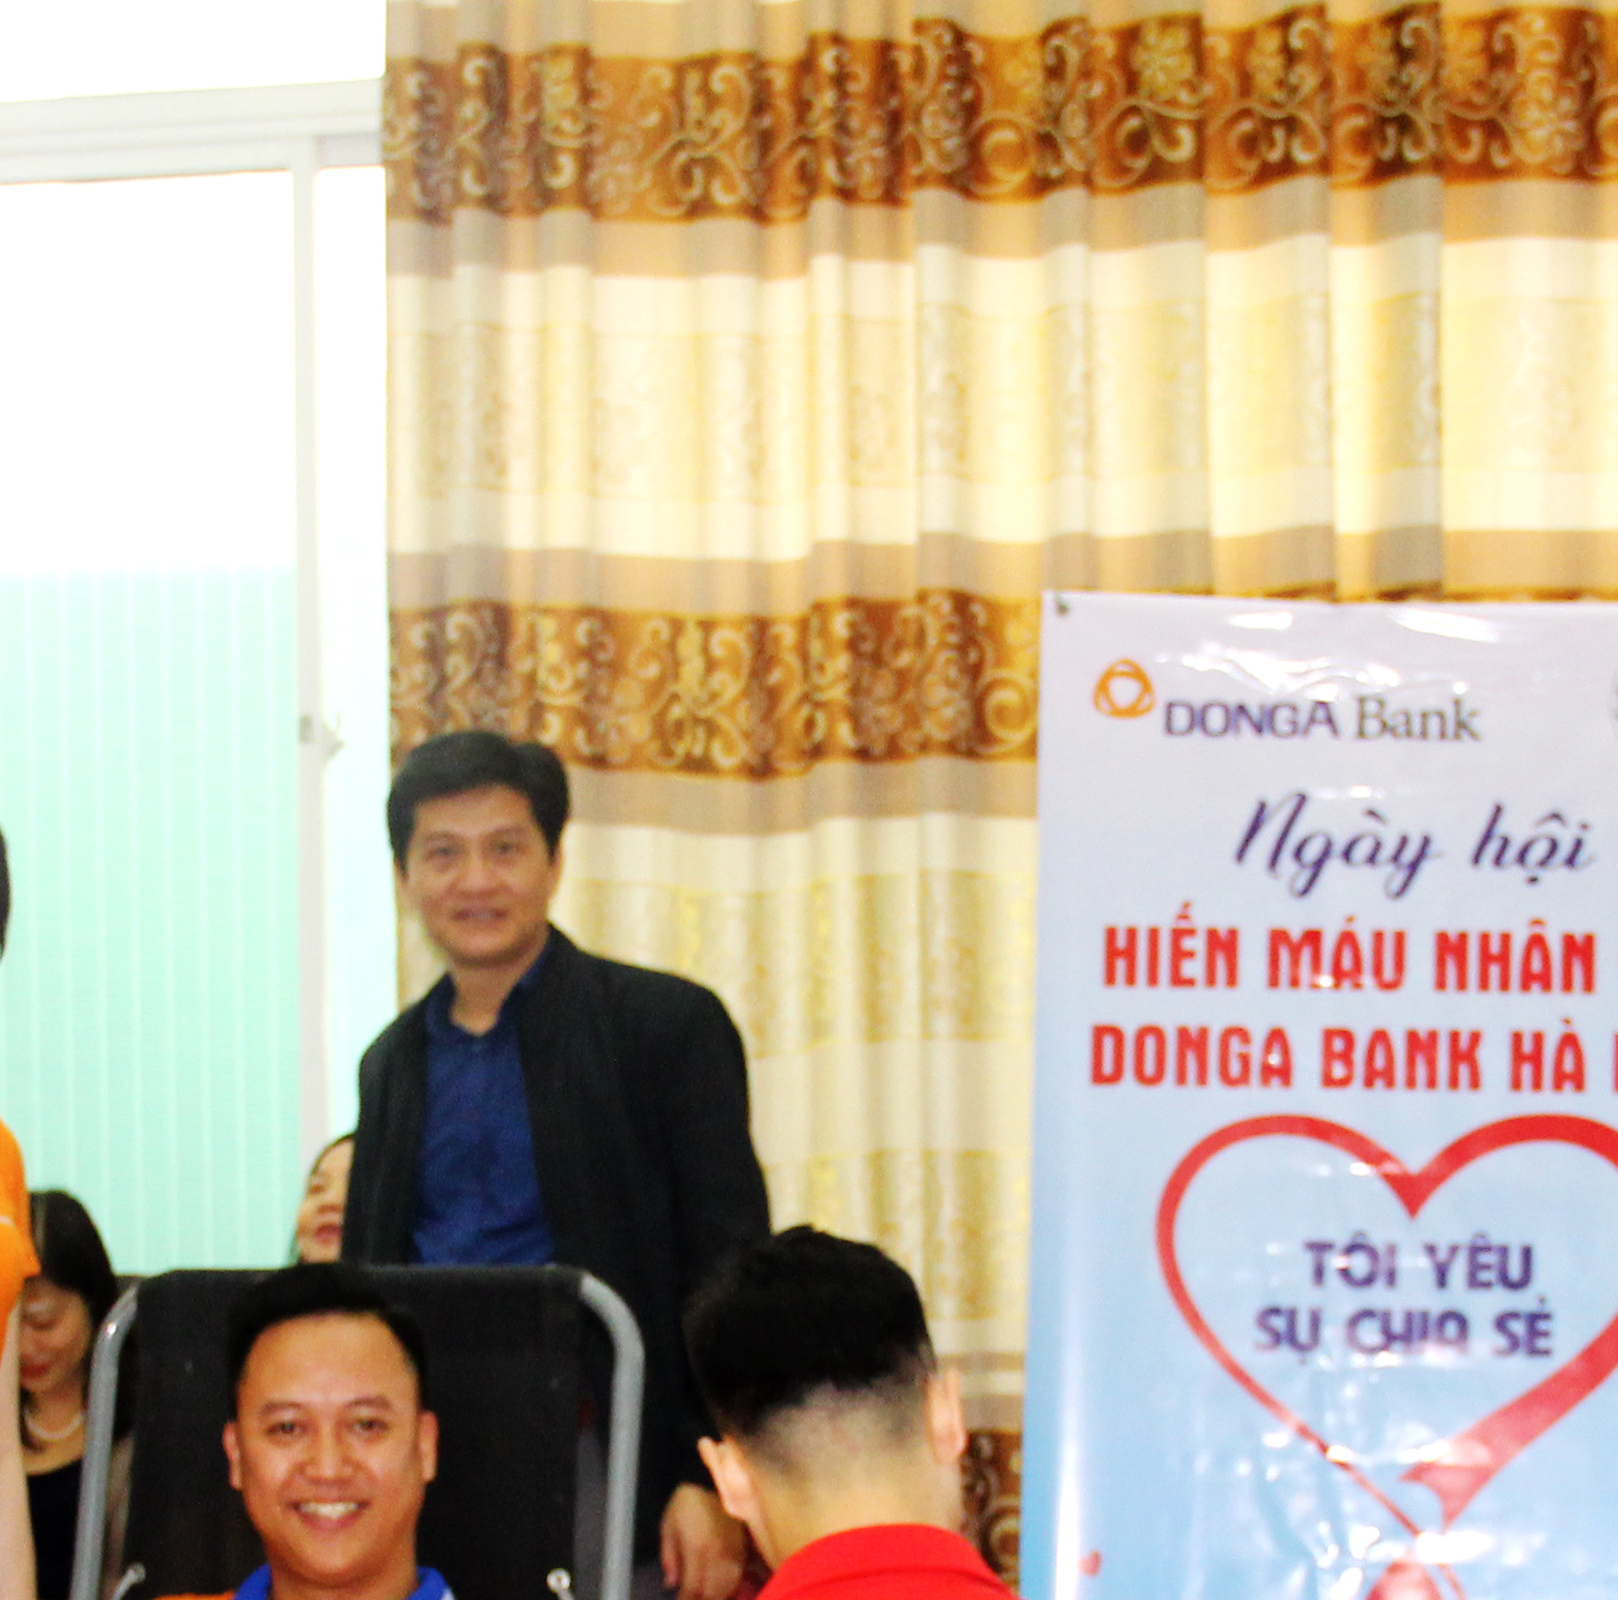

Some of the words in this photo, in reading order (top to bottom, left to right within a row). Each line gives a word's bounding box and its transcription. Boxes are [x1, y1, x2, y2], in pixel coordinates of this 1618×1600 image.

[1164, 699, 1338, 738] DONGA
[1356, 695, 1481, 741] Bank
[1234, 792, 1443, 899] Ngày
[1470, 802, 1595, 885] hội
[1103, 900, 1240, 989] HIẾN
[1266, 914, 1407, 992] MÁU
[1433, 918, 1597, 995] NHÂN
[1090, 1023, 1294, 1089] DONGA
[1320, 1026, 1483, 1092] BANK
[1509, 1016, 1587, 1094] HÀ
[1304, 1231, 1398, 1289] TÔI
[1424, 1233, 1534, 1291] YÊU
